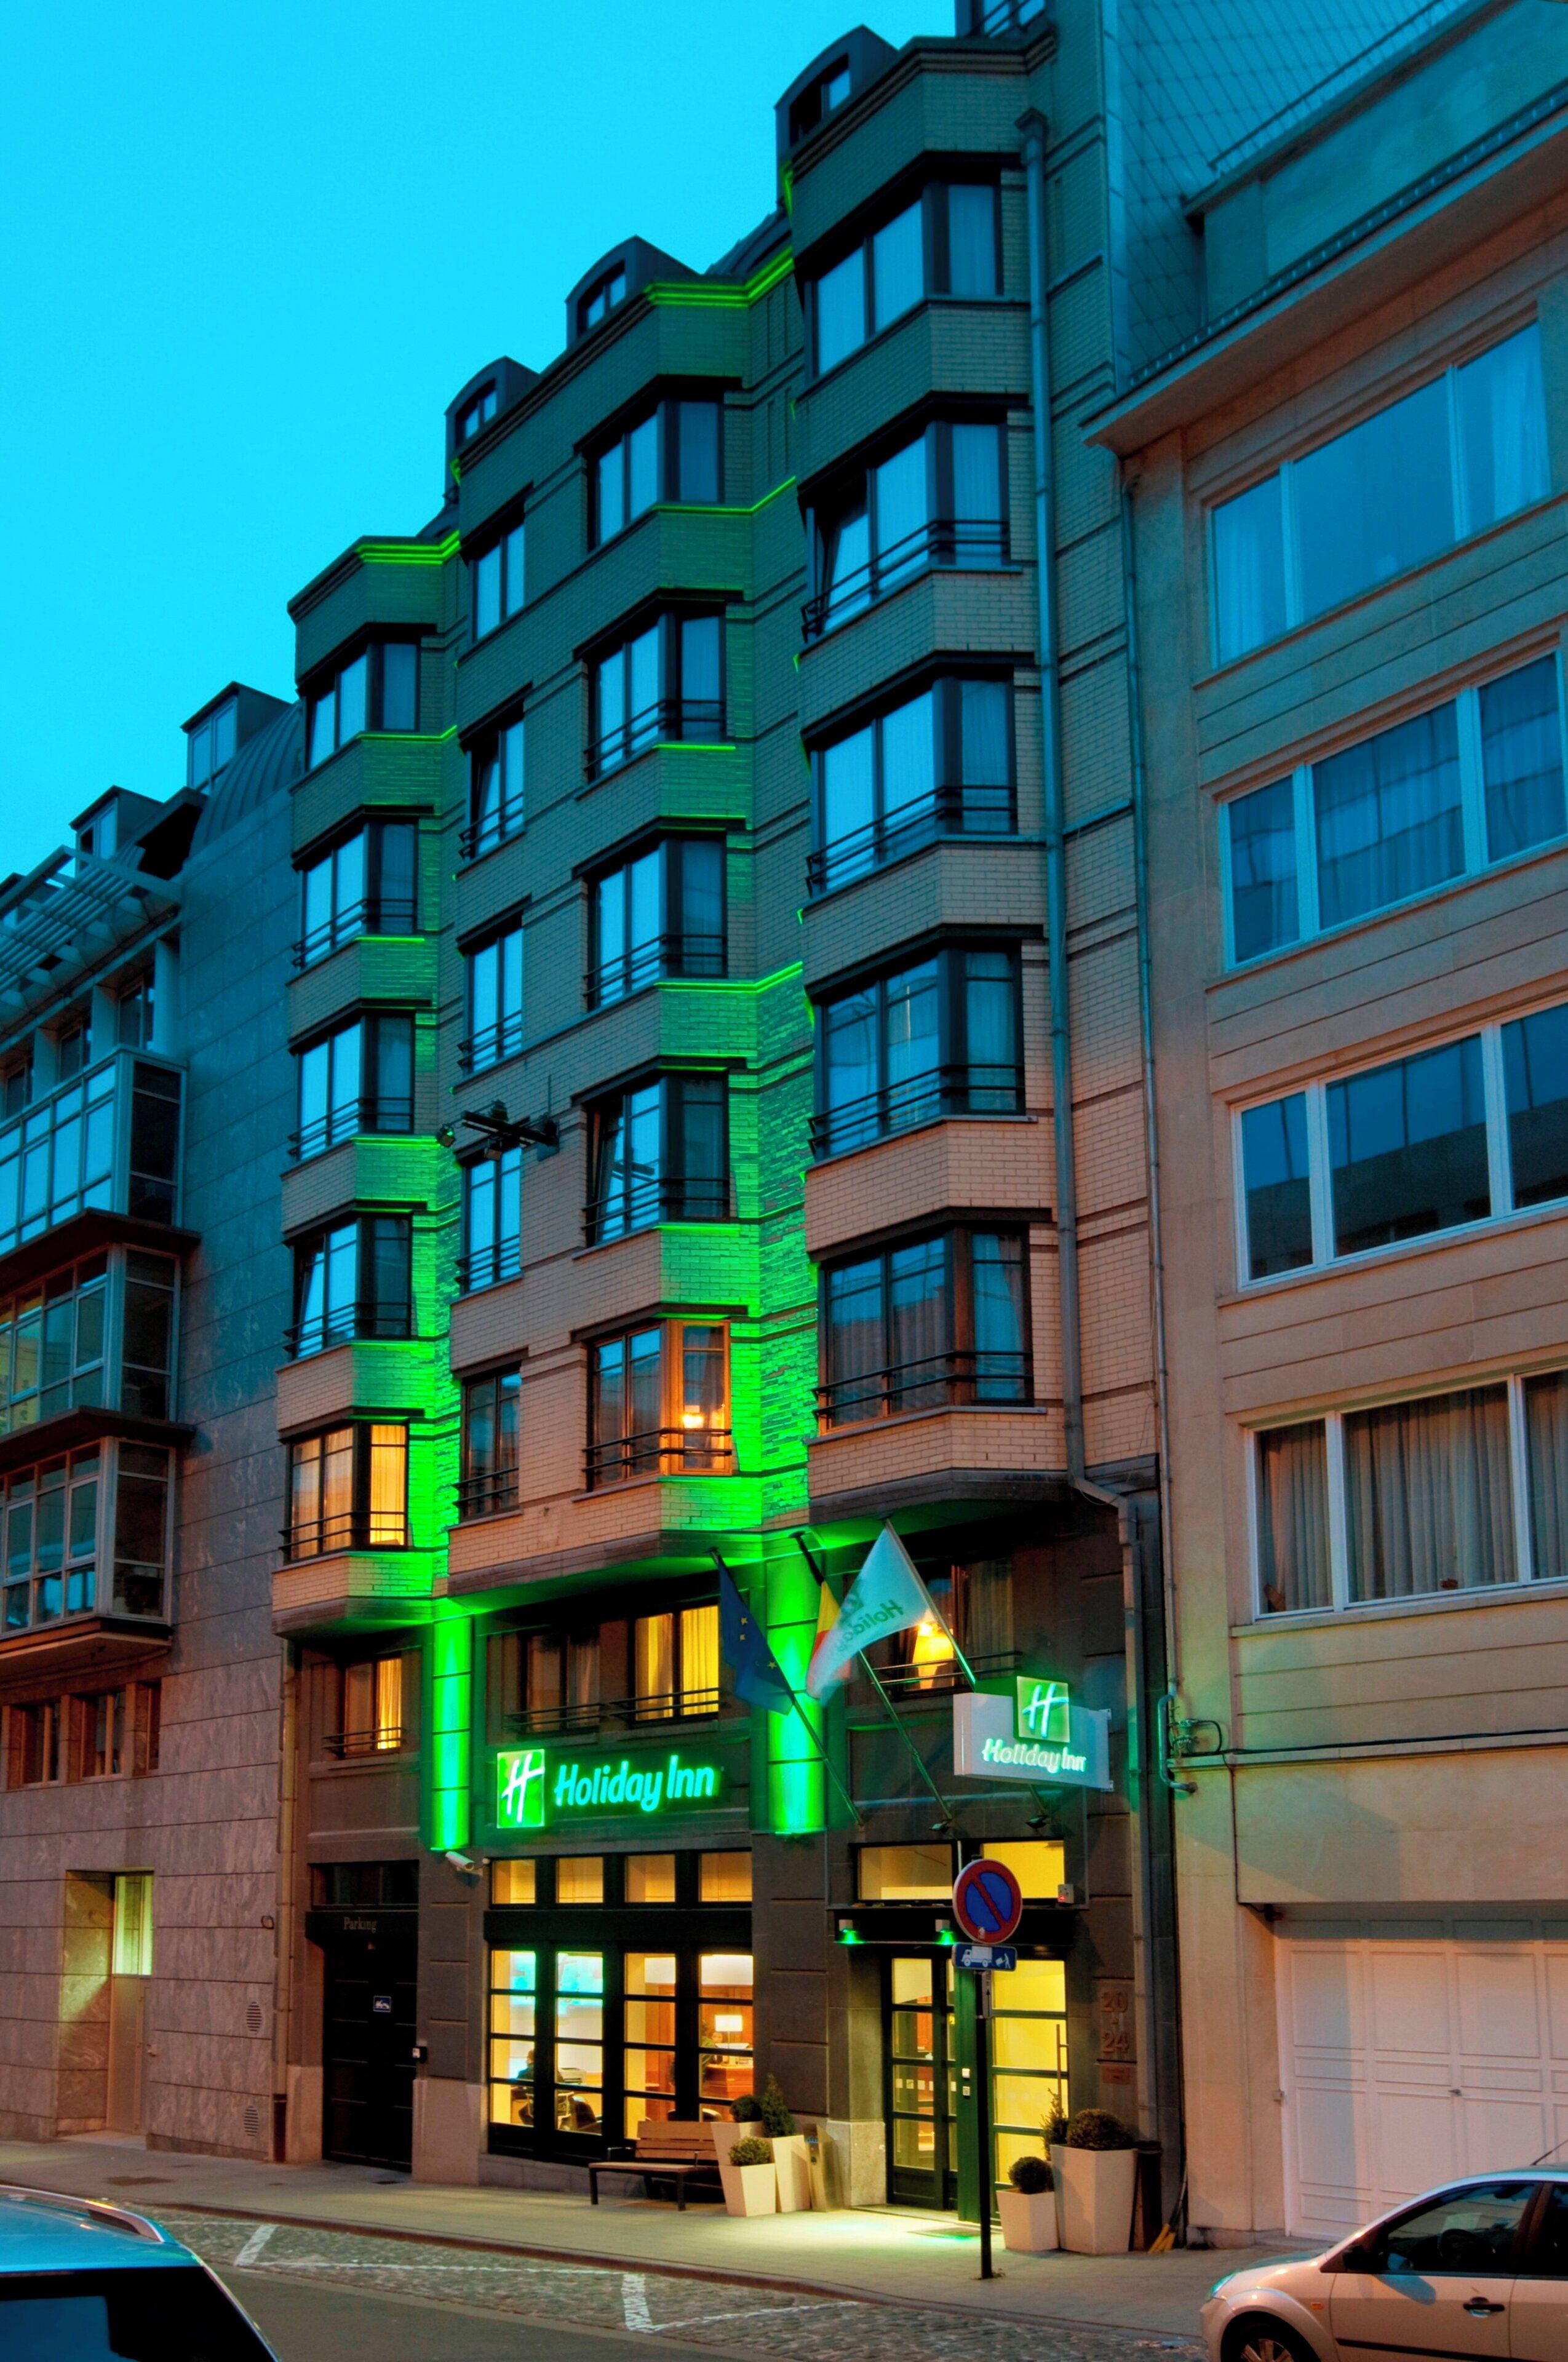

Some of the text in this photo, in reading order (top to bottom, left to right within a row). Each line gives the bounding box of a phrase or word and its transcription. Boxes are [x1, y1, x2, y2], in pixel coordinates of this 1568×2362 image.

[982, 1738, 1087, 1774] Holiday Inn
[554, 1754, 715, 1811] Holiday Inn
[343, 1916, 378, 1934] Parking
[1101, 1991, 1129, 2013] 20
[1102, 2030, 1129, 2054] 24
